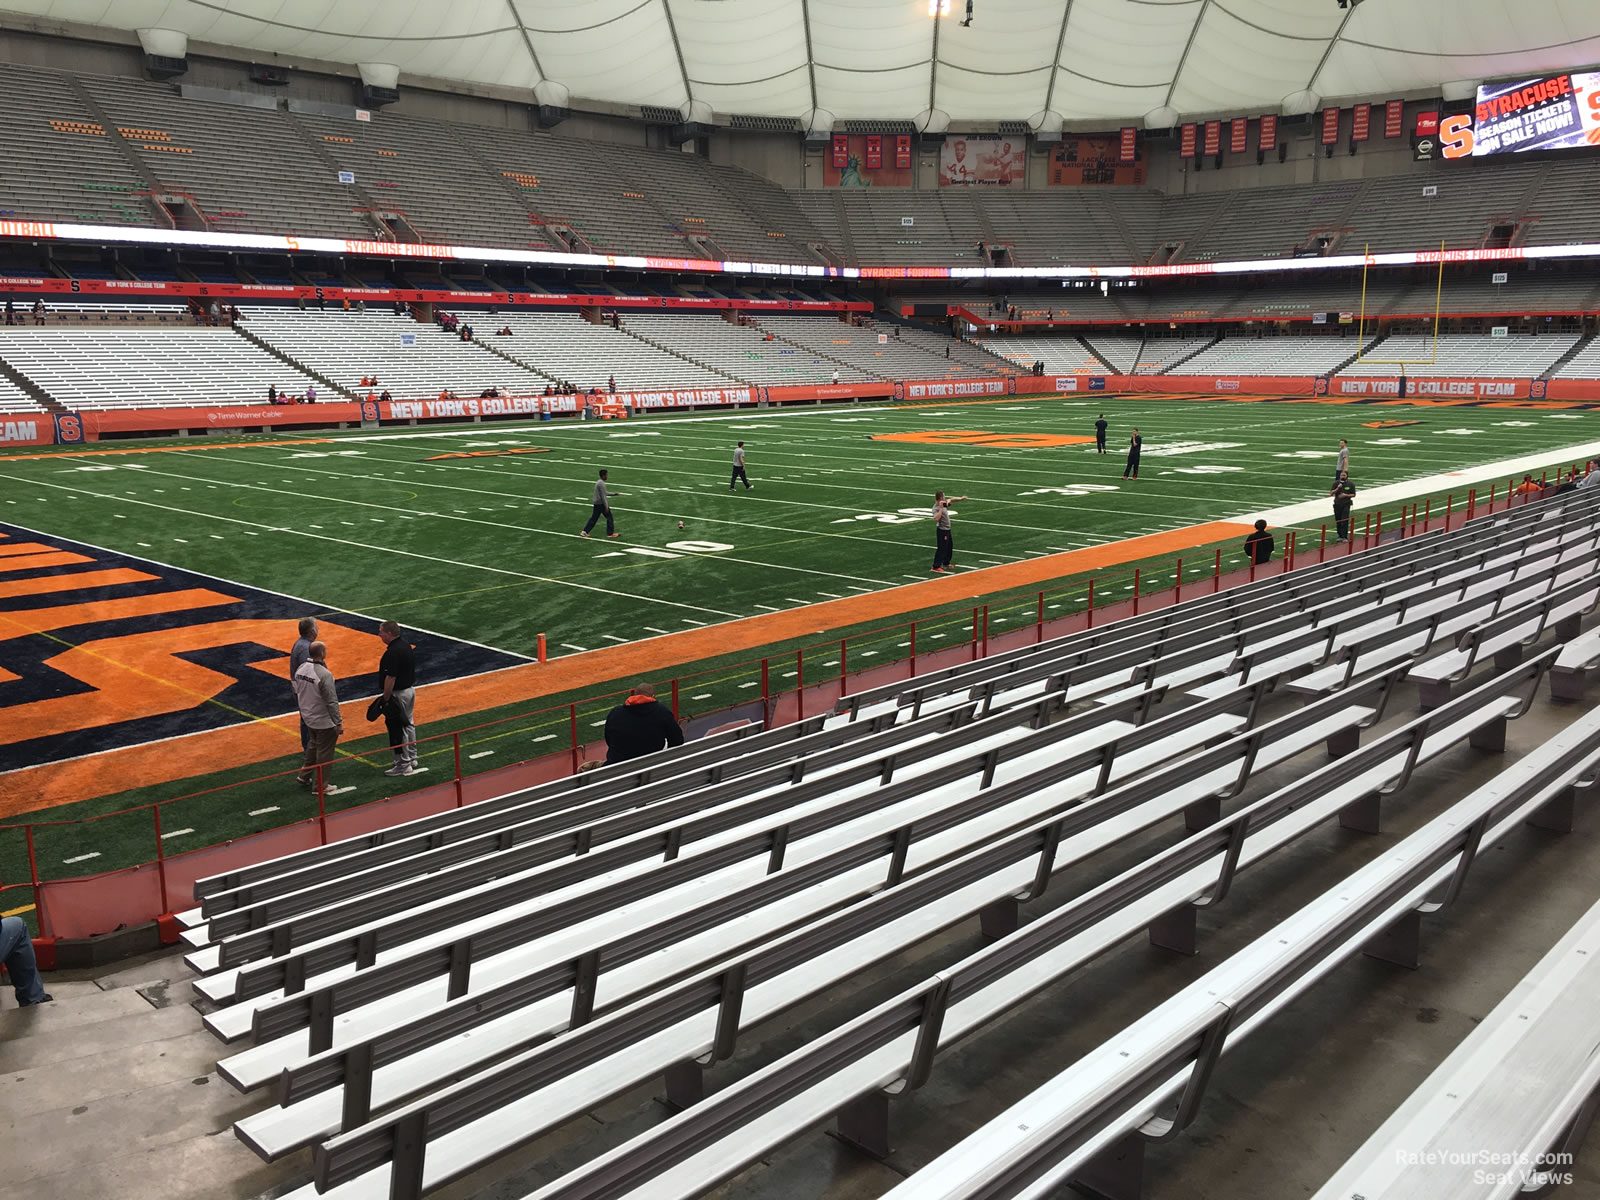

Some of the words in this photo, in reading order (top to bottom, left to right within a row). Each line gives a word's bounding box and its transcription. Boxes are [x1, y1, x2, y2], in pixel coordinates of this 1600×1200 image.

[1476, 75, 1571, 122] SYRACUSE
[1479, 116, 1523, 139] SEASON
[1522, 100, 1571, 125] TICKETS
[1440, 114, 1474, 159] S
[1480, 136, 1500, 151] ON
[1502, 123, 1535, 145] SALE
[1536, 111, 1574, 136] NOW!
[286, 235, 299, 251] S
[345, 240, 401, 256] SYRACUSE
[405, 243, 455, 258] FOOTBALL
[1415, 250, 1469, 264] SYRACUSE
[1472, 247, 1524, 261] FOOTBALL
[861, 267, 906, 278] SYRACUSE
[907, 267, 949, 278] FOOTBALL
[71, 280, 81, 292] S
[910, 385, 925, 396] NEW
[928, 383, 953, 395] YORK'S
[955, 382, 984, 394] COLLEGE
[986, 381, 1003, 393] TEAM
[1341, 381, 1368, 393] NEW
[1371, 381, 1415, 394] YORS
[1419, 382, 1475, 395] COLLEGE
[1479, 383, 1515, 395] TEAM
[1531, 381, 1546, 398] S
[634, 391, 674, 408] YORK'S
[677, 389, 717, 405] COLLEGE
[719, 387, 749, 403] TEAM
[363, 403, 377, 420] S
[390, 402, 423, 419] NEW
[426, 400, 479, 417] YORK'S
[482, 397, 539, 415] COLLEGE
[542, 395, 577, 413] TEAM
[217, 412, 235, 420] Time
[58, 416, 80, 441] S
[621, 541, 735, 559] 10
